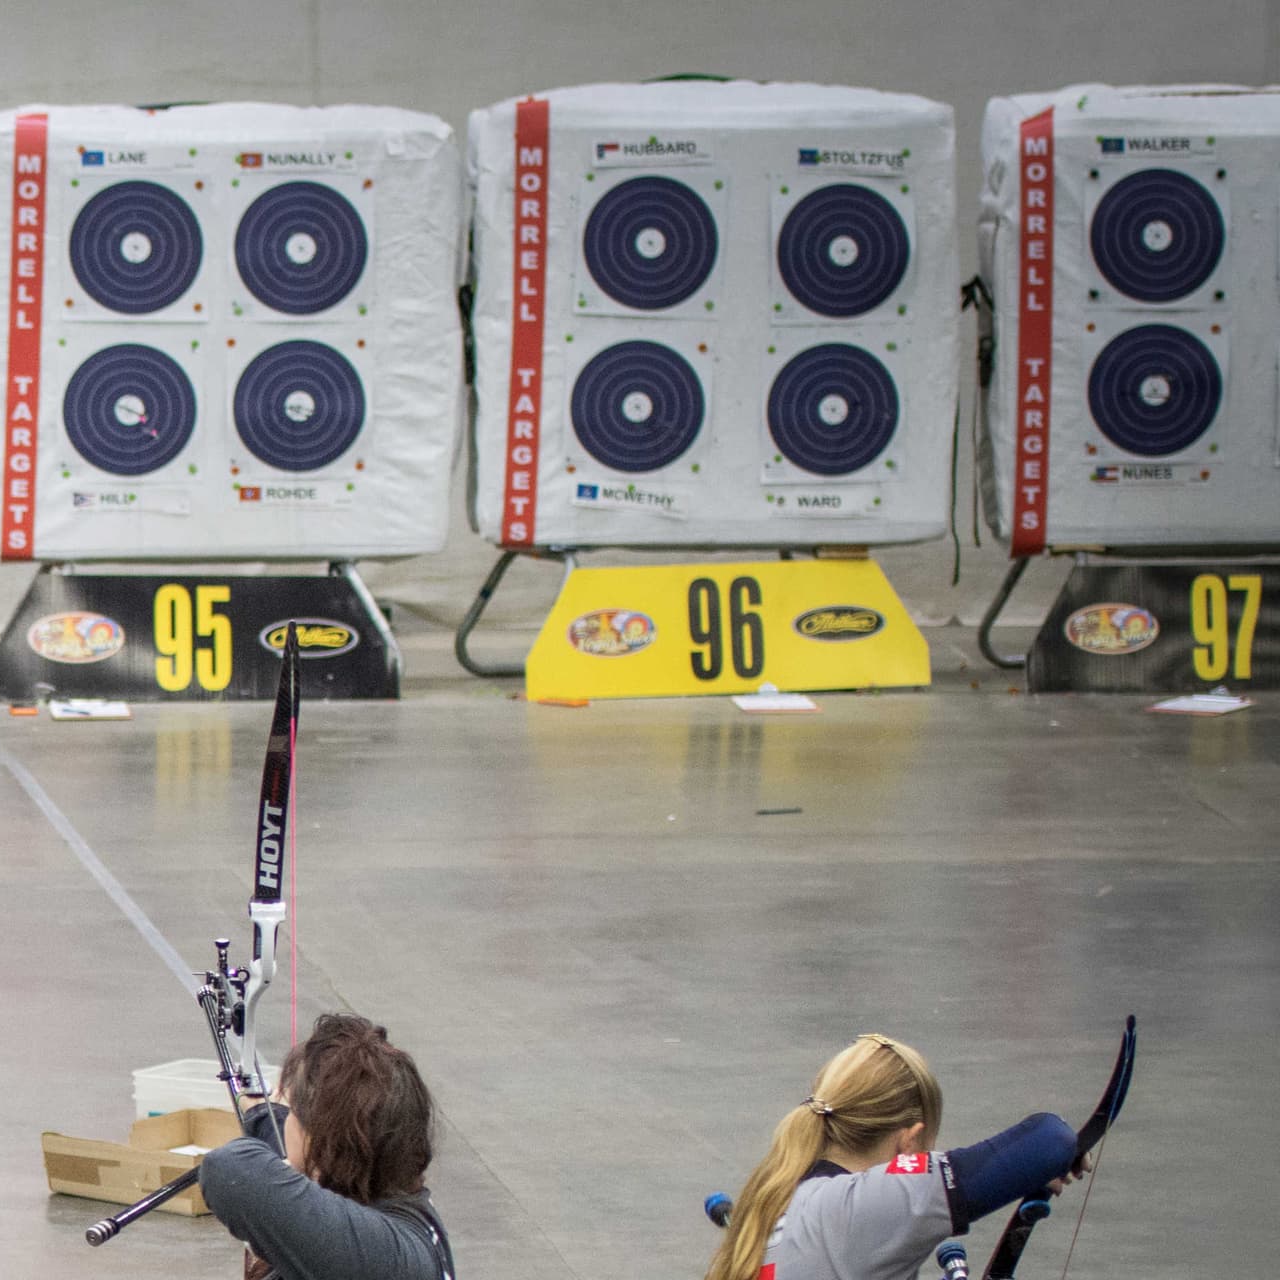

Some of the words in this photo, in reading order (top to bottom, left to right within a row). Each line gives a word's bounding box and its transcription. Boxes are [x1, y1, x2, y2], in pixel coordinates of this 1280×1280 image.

[108, 152, 148, 165] LANE
[268, 152, 337, 165] NUNALLY
[624, 141, 697, 156] HUBBARD
[1128, 138, 1191, 150] WALKER
[17, 155, 40, 330] MORRELL
[520, 148, 542, 321] MORRELL
[1025, 138, 1047, 312] MORRELL
[8, 376, 34, 550] TARGETS
[266, 487, 317, 499] ROHDE
[510, 369, 536, 542] TARGETS
[1021, 358, 1046, 530] TARGETS
[1123, 467, 1173, 480] NUNES
[797, 495, 842, 509] WARD
[153, 583, 233, 692] 95
[687, 575, 766, 681] 96
[1190, 574, 1262, 681] 97
[258, 800, 284, 889] HOYT
